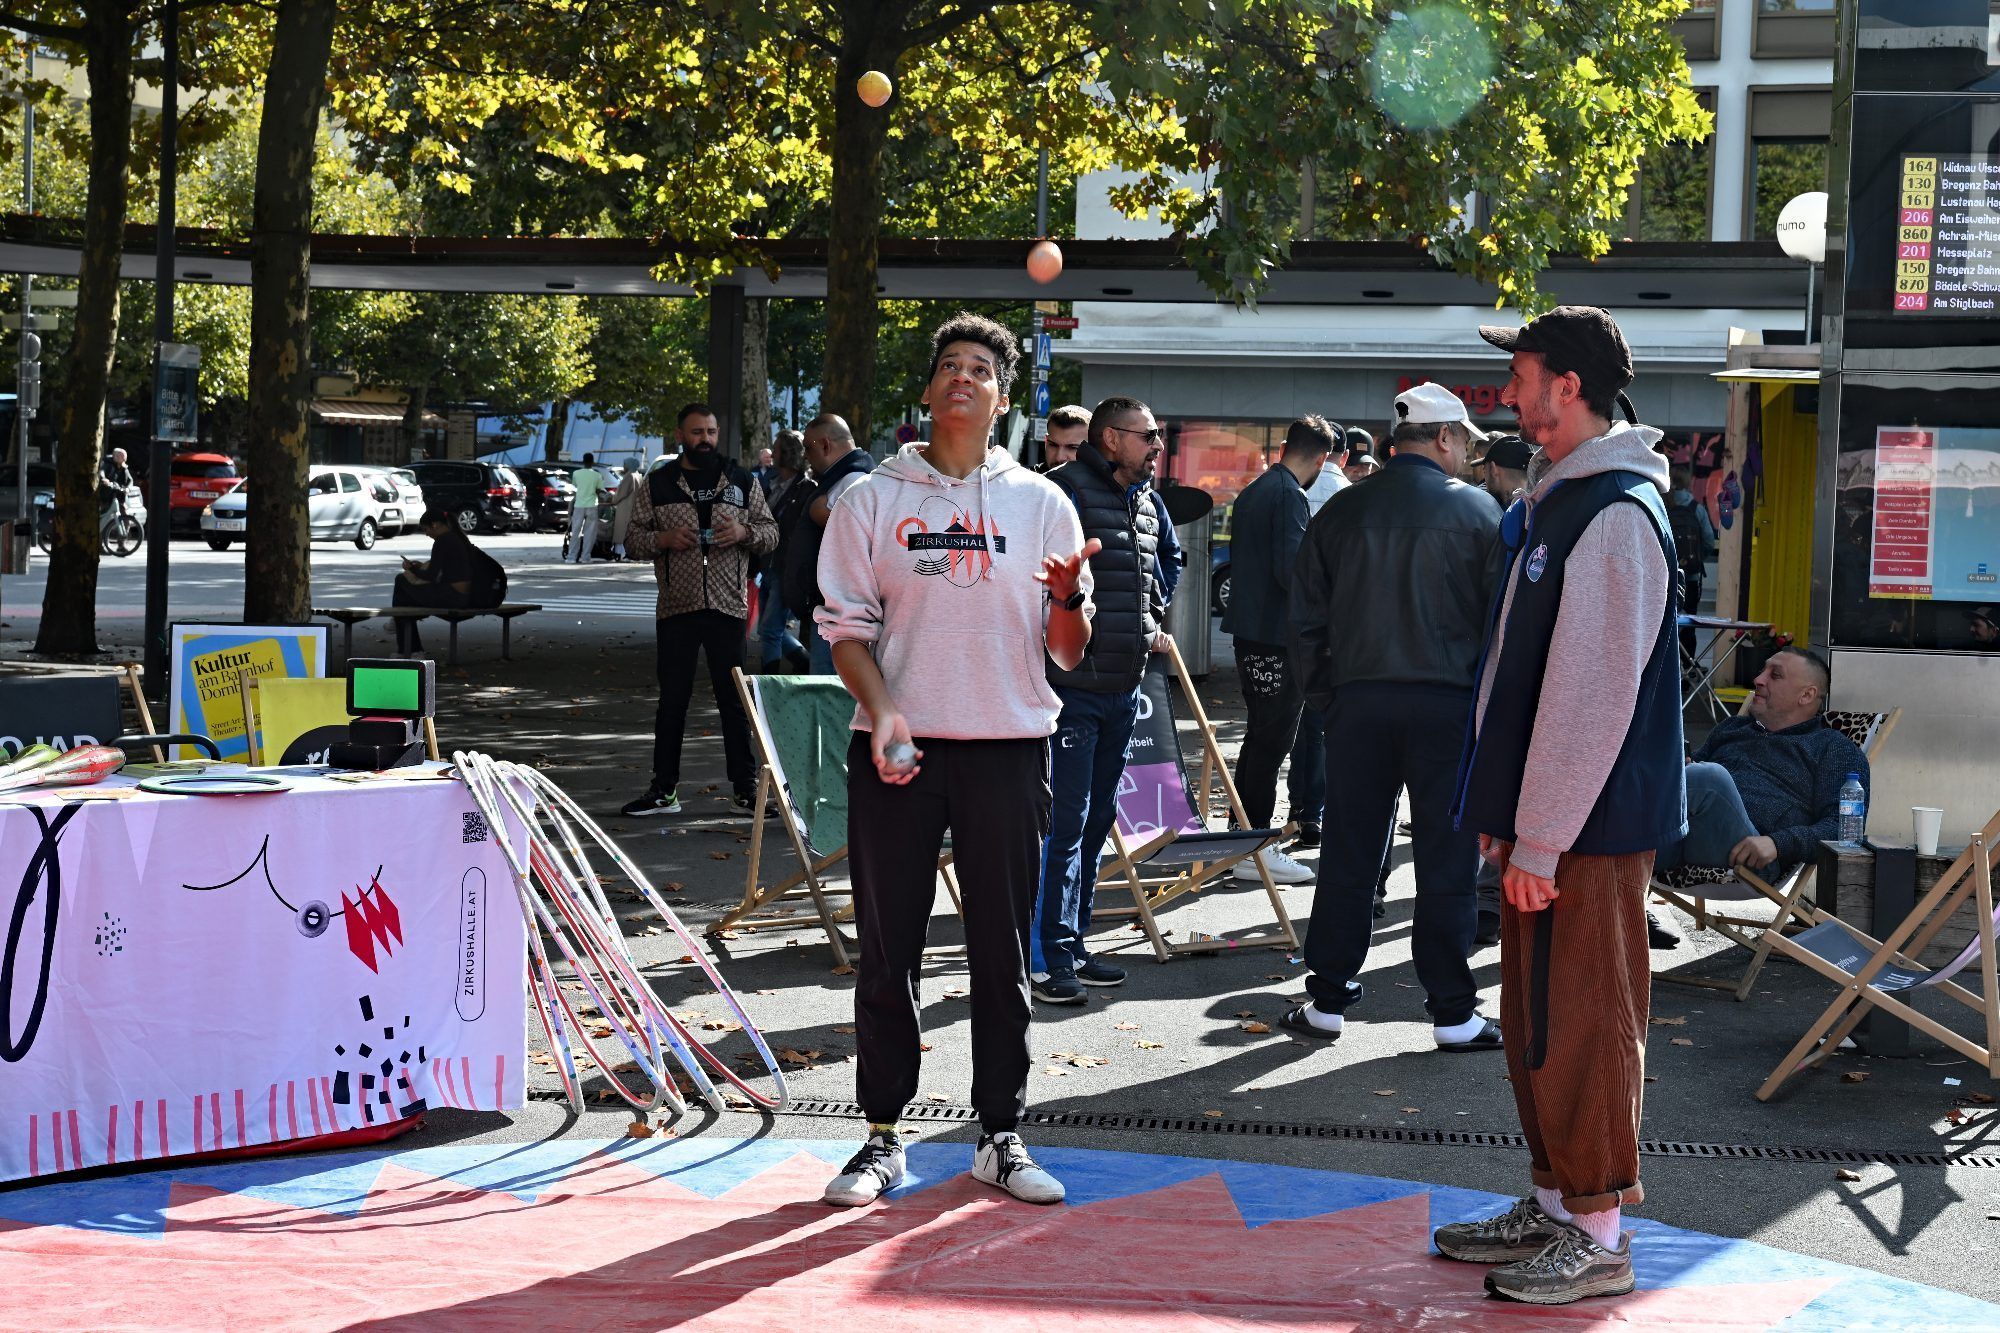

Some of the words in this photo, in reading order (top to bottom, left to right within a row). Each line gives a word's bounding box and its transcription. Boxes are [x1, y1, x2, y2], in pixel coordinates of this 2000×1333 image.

[1908, 160, 1933, 172] 164
[1943, 161, 1976, 173] Widnau
[1907, 177, 1931, 189] 130
[1942, 178, 1982, 192] Bregenz
[1906, 194, 1930, 206] 161
[1940, 195, 1985, 207] Lustenau
[1904, 211, 1929, 223] 206
[1940, 212, 1954, 224] Am
[1902, 228, 1928, 240] 860
[1901, 245, 1926, 257] 201
[1937, 246, 1993, 260] Messeplatz
[1901, 262, 1926, 274] 150
[1936, 263, 1976, 277] Bregenz
[1899, 279, 1925, 290] 870
[1898, 295, 1924, 307] 204
[1933, 296, 1948, 308] Am
[1949, 297, 1995, 311] Stiglbach
[161, 388, 179, 400] Bitte
[914, 536, 1000, 549] ZIRKUSHALE
[194, 652, 251, 676] Kultur
[199, 676, 219, 689] am
[1129, 736, 1155, 748] rbeit
[464, 890, 477, 996] ZIRKUSHALLE.AT
